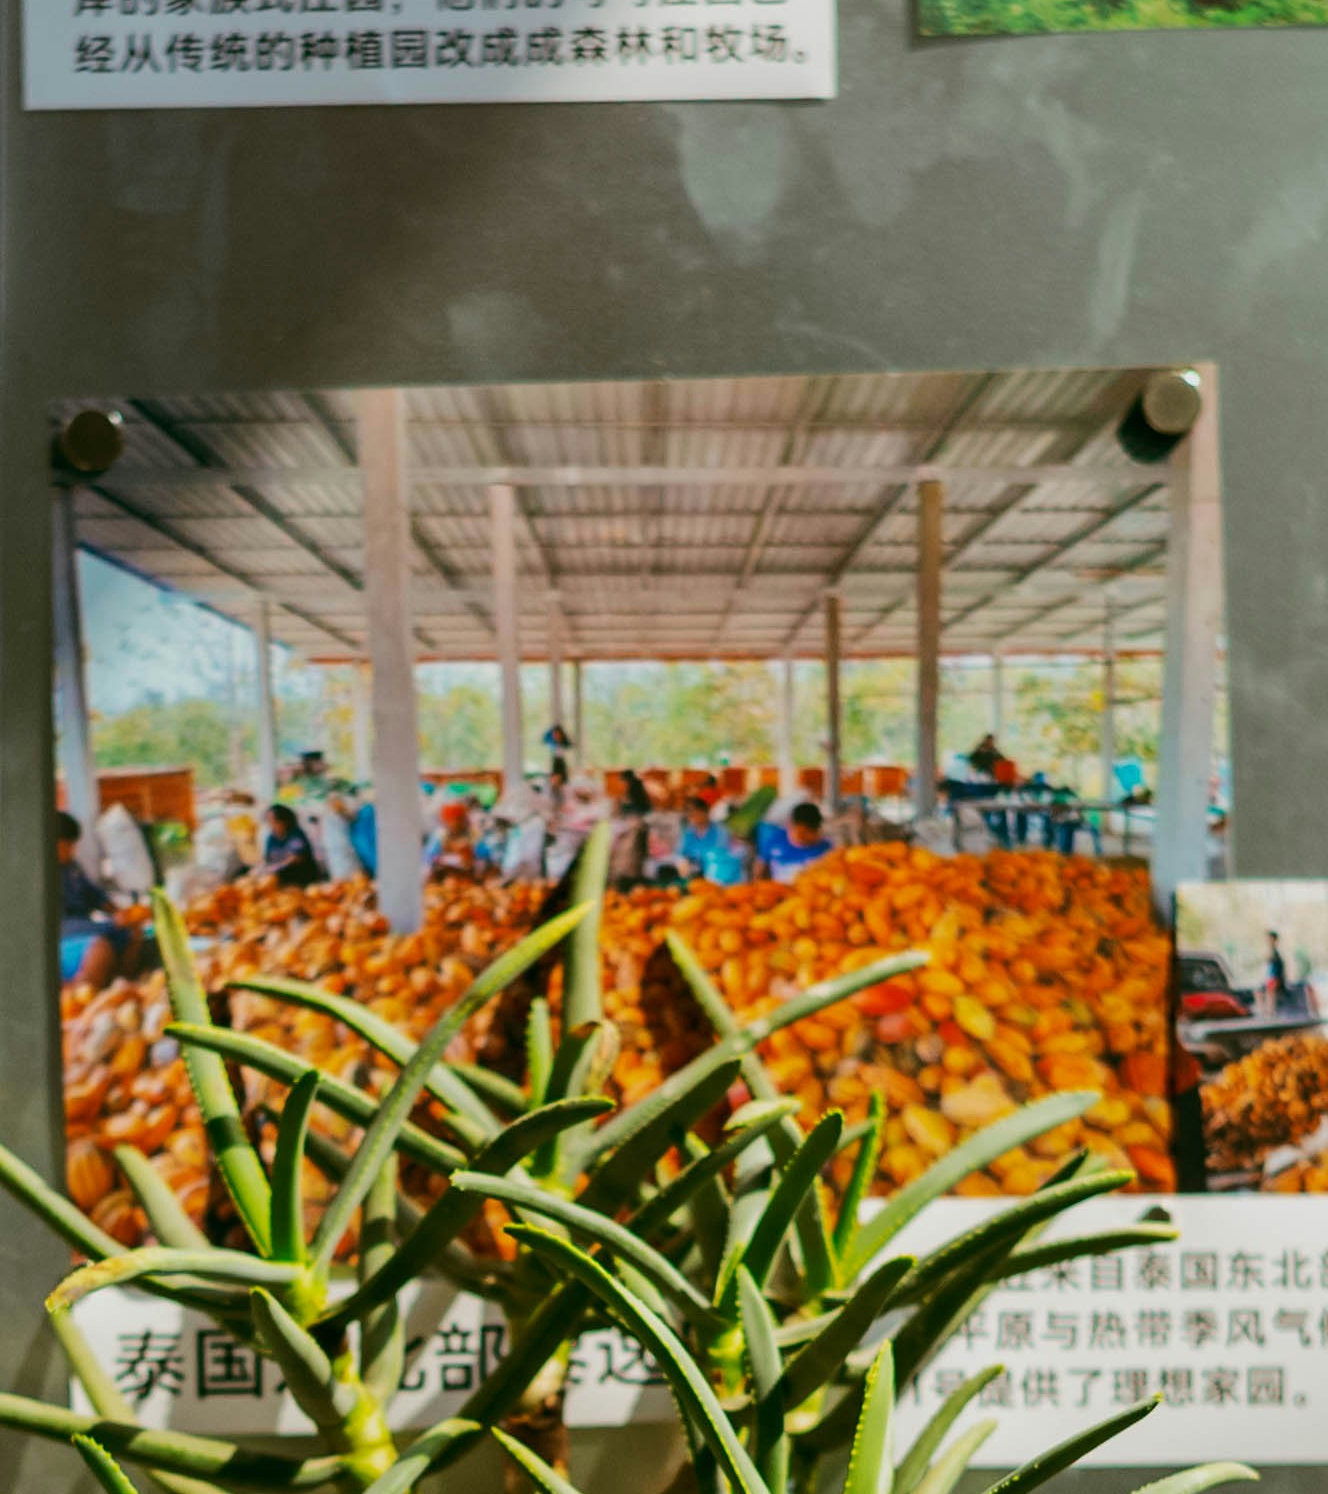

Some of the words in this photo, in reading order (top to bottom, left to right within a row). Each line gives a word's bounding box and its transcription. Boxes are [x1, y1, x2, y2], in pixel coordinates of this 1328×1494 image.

[72, 22, 810, 73] 经从传统的种植园改成成森林和牧场。
